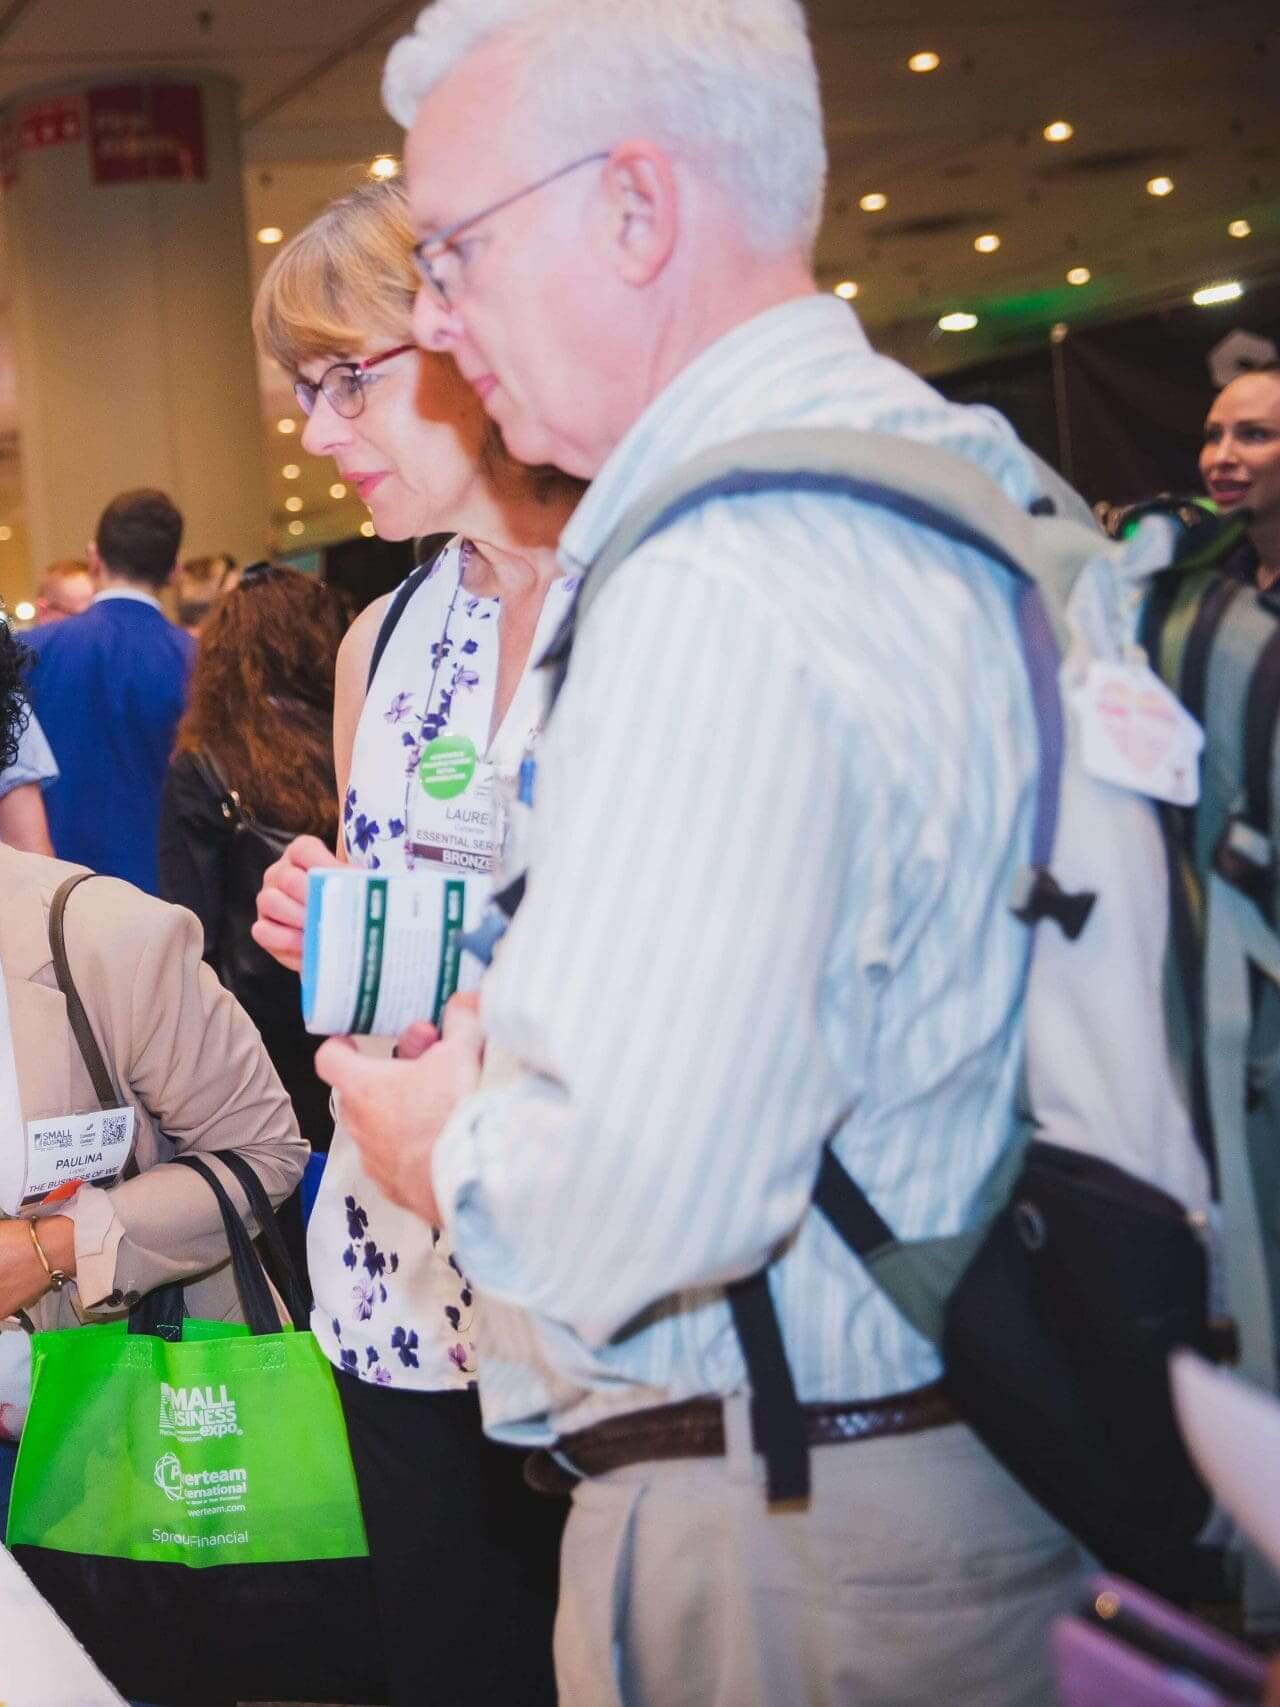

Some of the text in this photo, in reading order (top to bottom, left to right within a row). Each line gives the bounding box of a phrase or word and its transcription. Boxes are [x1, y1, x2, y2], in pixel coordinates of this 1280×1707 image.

[445, 807, 489, 826] LAURE
[416, 829, 469, 848] ESSENTIAL
[442, 850, 491, 870] BRONZE
[43, 1128, 72, 1141] SMALL
[55, 1152, 103, 1170] PAULINA
[29, 1182, 46, 1193] THE
[92, 1169, 104, 1179] OF
[175, 1407, 237, 1427] SINESS
